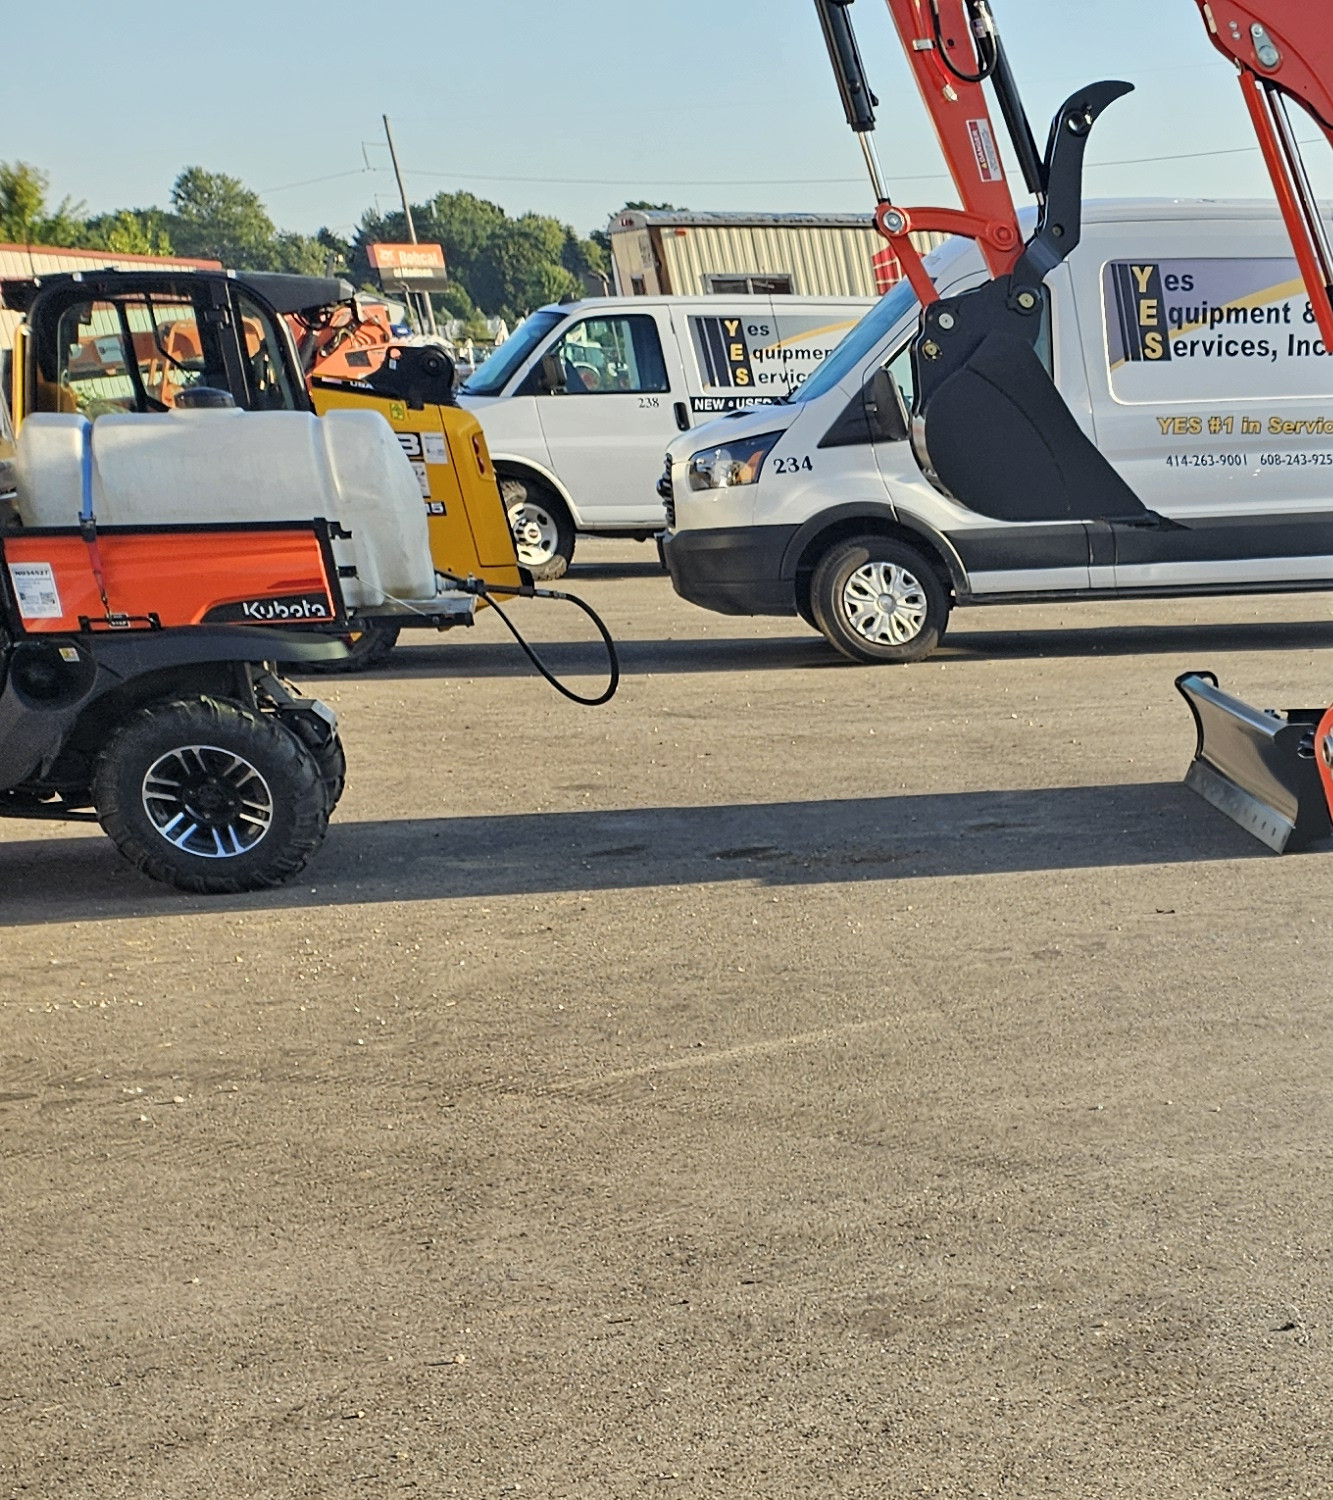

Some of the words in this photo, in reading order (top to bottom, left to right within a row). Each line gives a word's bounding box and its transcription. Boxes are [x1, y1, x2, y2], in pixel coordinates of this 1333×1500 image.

[398, 251, 439, 266] Bobcat
[1131, 266, 1195, 293] Yes
[1139, 299, 1291, 330] Equipment
[638, 398, 660, 409] 238
[694, 398, 725, 411] NEW
[1157, 416, 1203, 435] YES
[1208, 416, 1234, 434] #1
[1241, 416, 1262, 434] in
[773, 456, 813, 475] 234
[1166, 454, 1248, 467] 414-263-9001
[242, 599, 326, 620] Kubota
